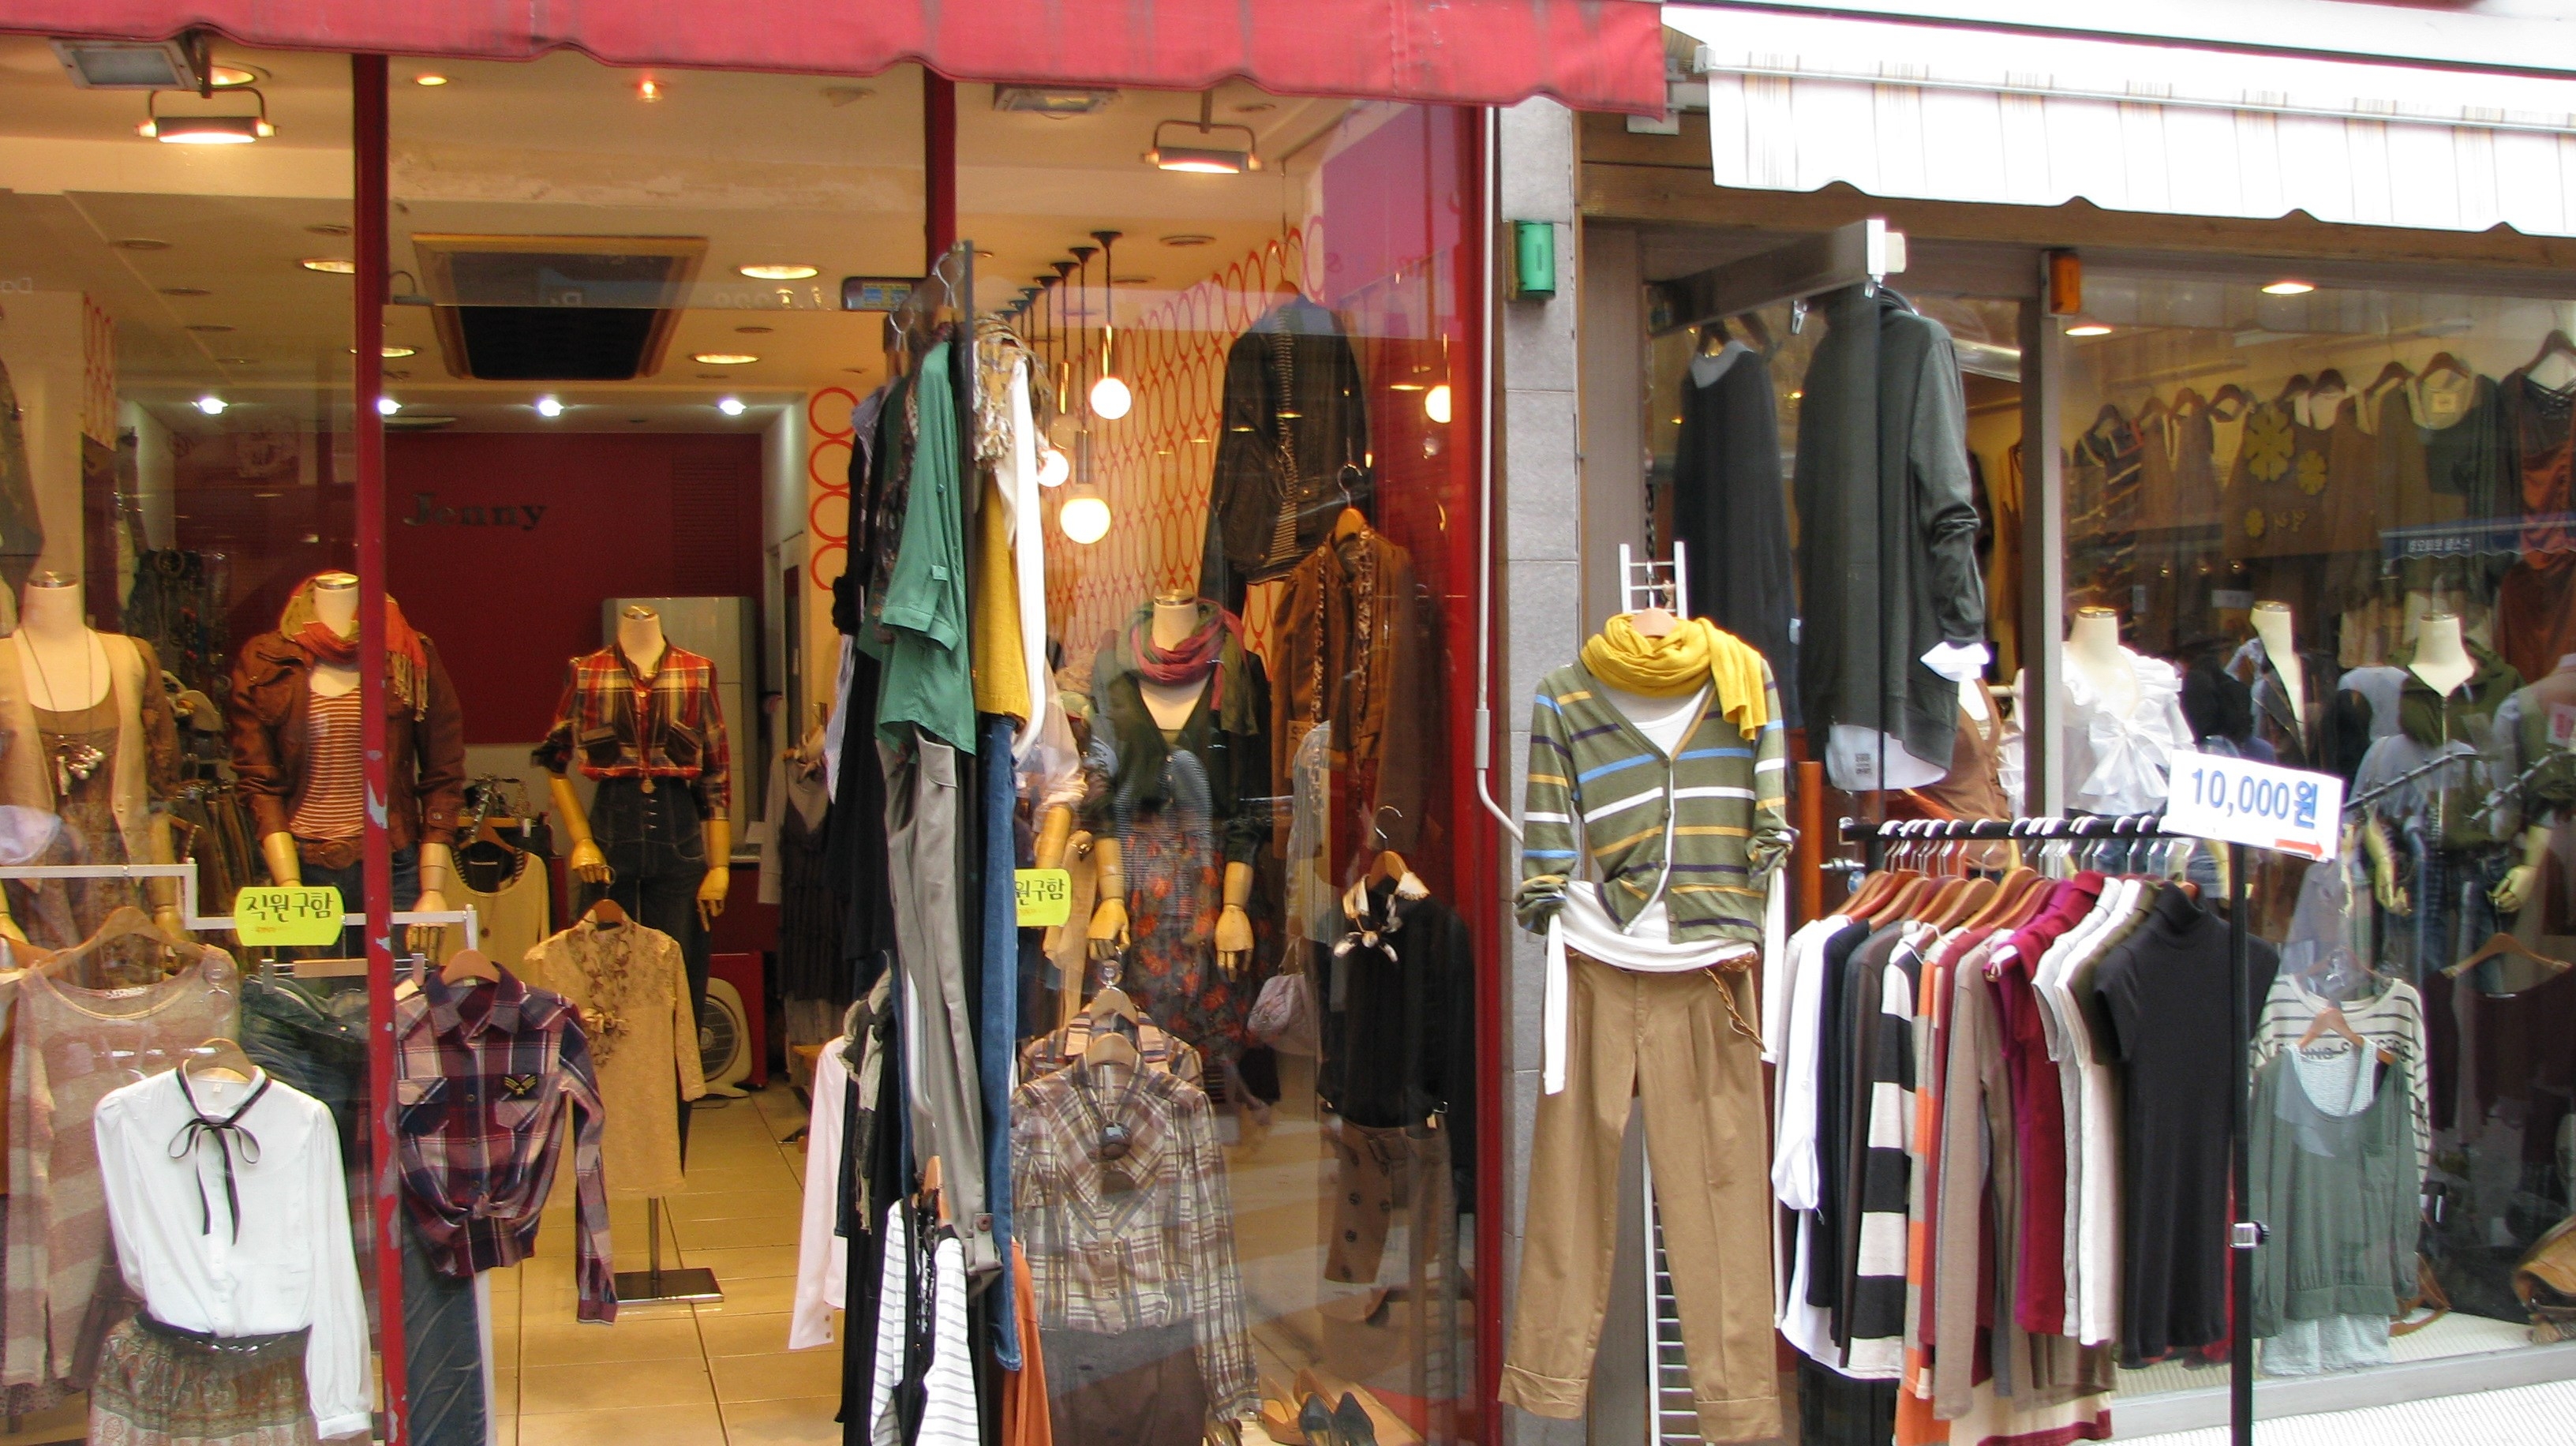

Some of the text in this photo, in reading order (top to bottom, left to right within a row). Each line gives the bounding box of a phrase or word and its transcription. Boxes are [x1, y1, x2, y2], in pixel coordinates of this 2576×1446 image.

[403, 493, 547, 530] Jenny
[2191, 767, 2319, 829] 10,000원
[243, 892, 334, 923] 직원구함
[1015, 878, 1065, 906] 원구함
